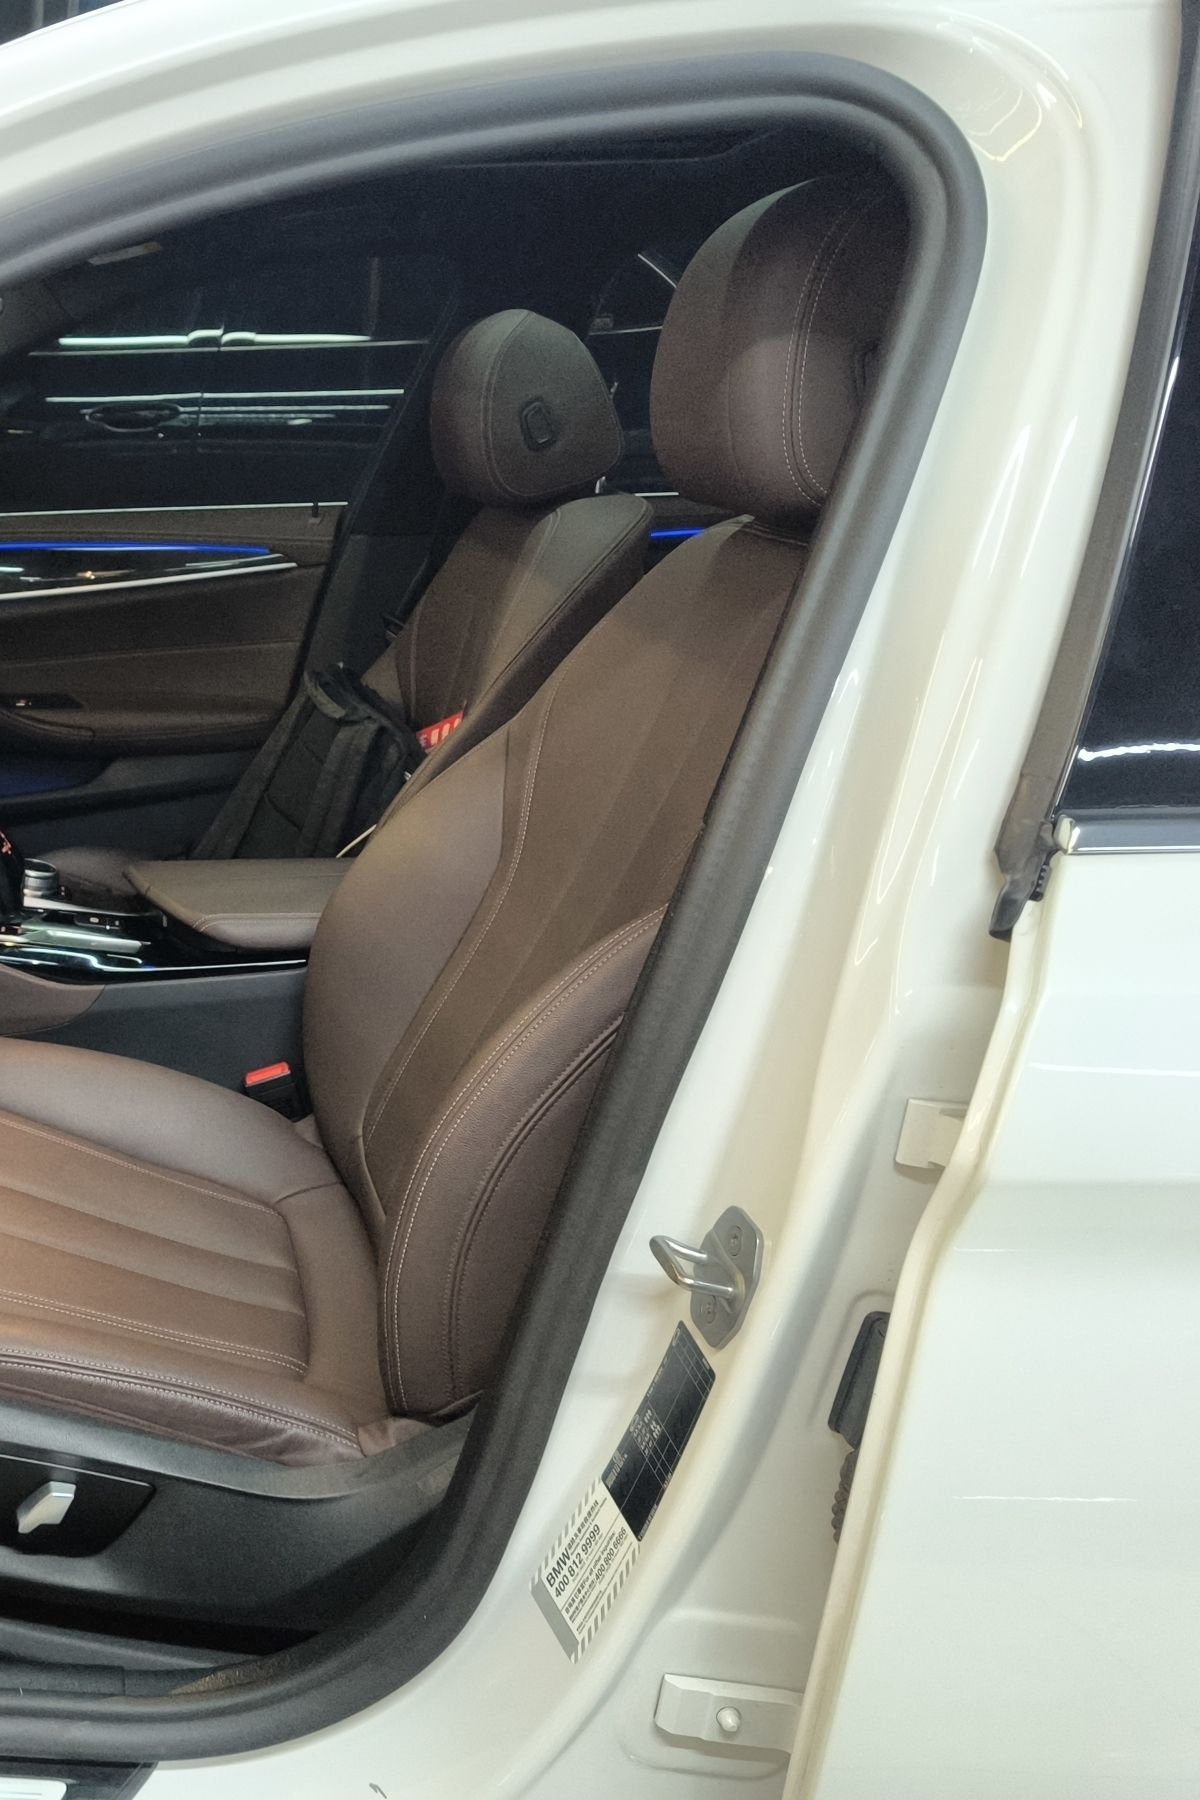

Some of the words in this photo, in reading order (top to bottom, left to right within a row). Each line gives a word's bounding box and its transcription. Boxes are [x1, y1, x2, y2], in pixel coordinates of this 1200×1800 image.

[546, 1547, 572, 1589] BMW
[554, 1573, 570, 1600] 400
[567, 1551, 584, 1579] 812
[580, 1522, 602, 1556] 9999
[594, 1562, 606, 1582] 400
[603, 1547, 615, 1566] 800
[612, 1526, 627, 1551] 6666
